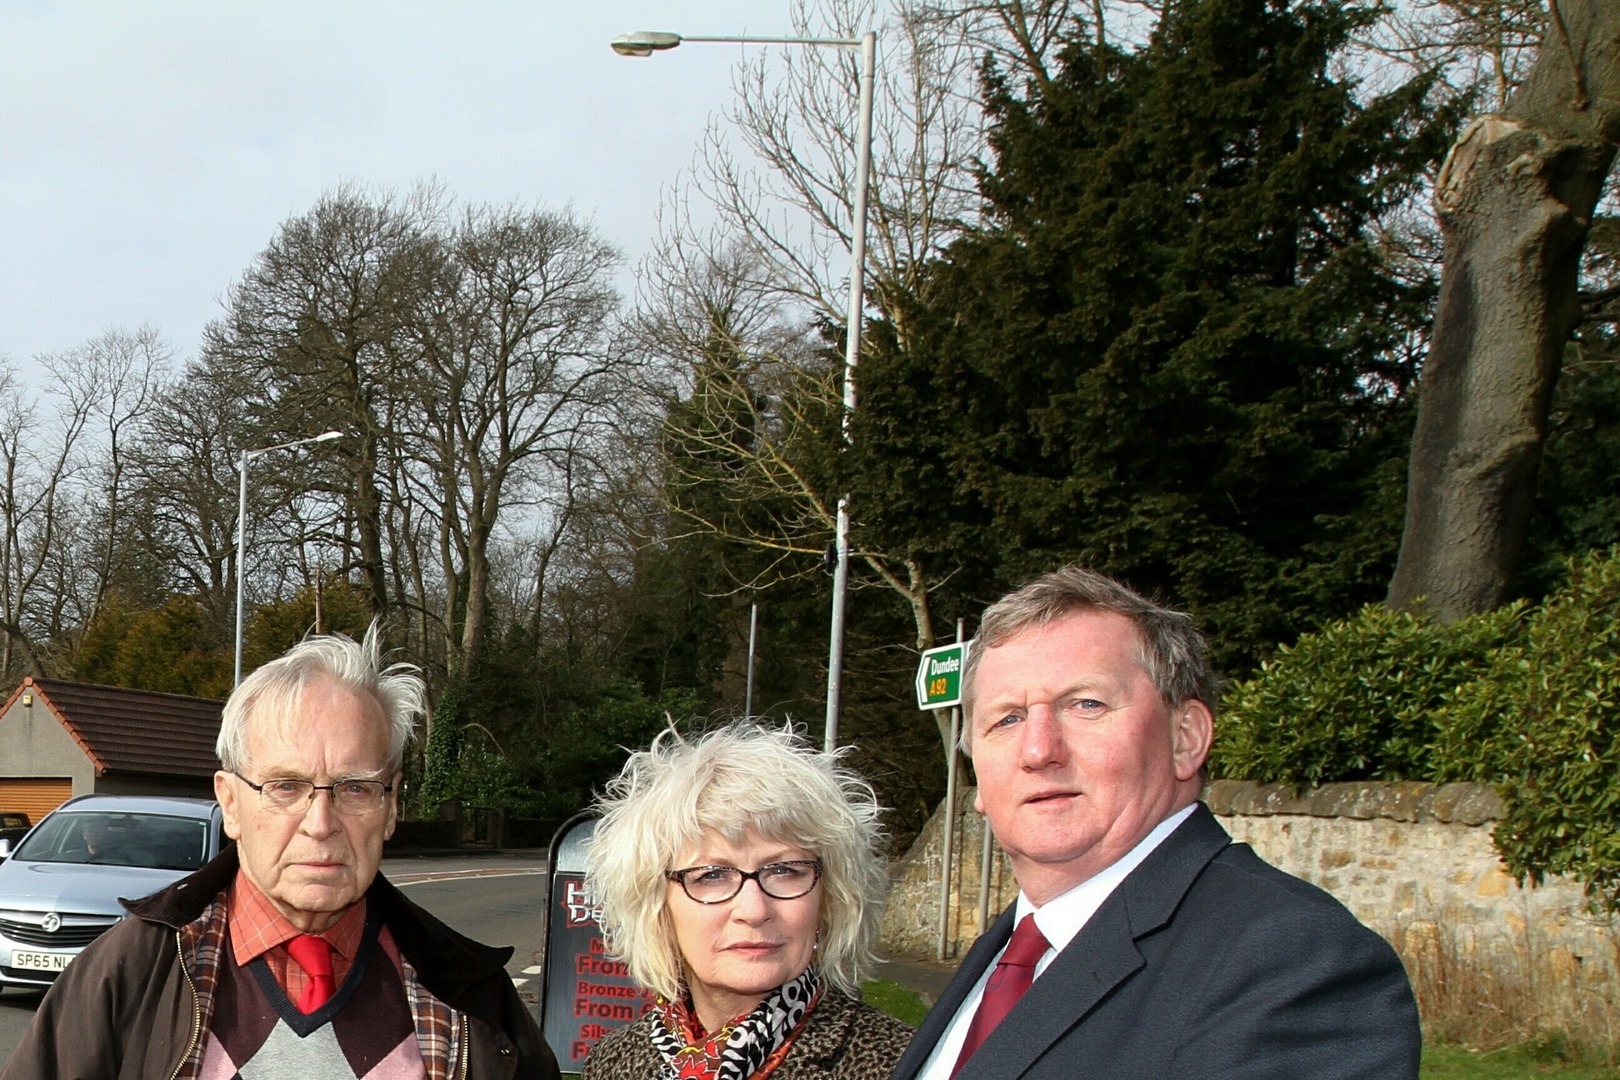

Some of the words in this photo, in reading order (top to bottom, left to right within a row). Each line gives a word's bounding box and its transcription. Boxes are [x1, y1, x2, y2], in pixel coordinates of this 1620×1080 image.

[931, 657, 959, 676] Dundee
[930, 678, 947, 696] A92
[17, 954, 51, 968] SP65
[577, 981, 637, 998] Bronze
[575, 998, 634, 1020] From
